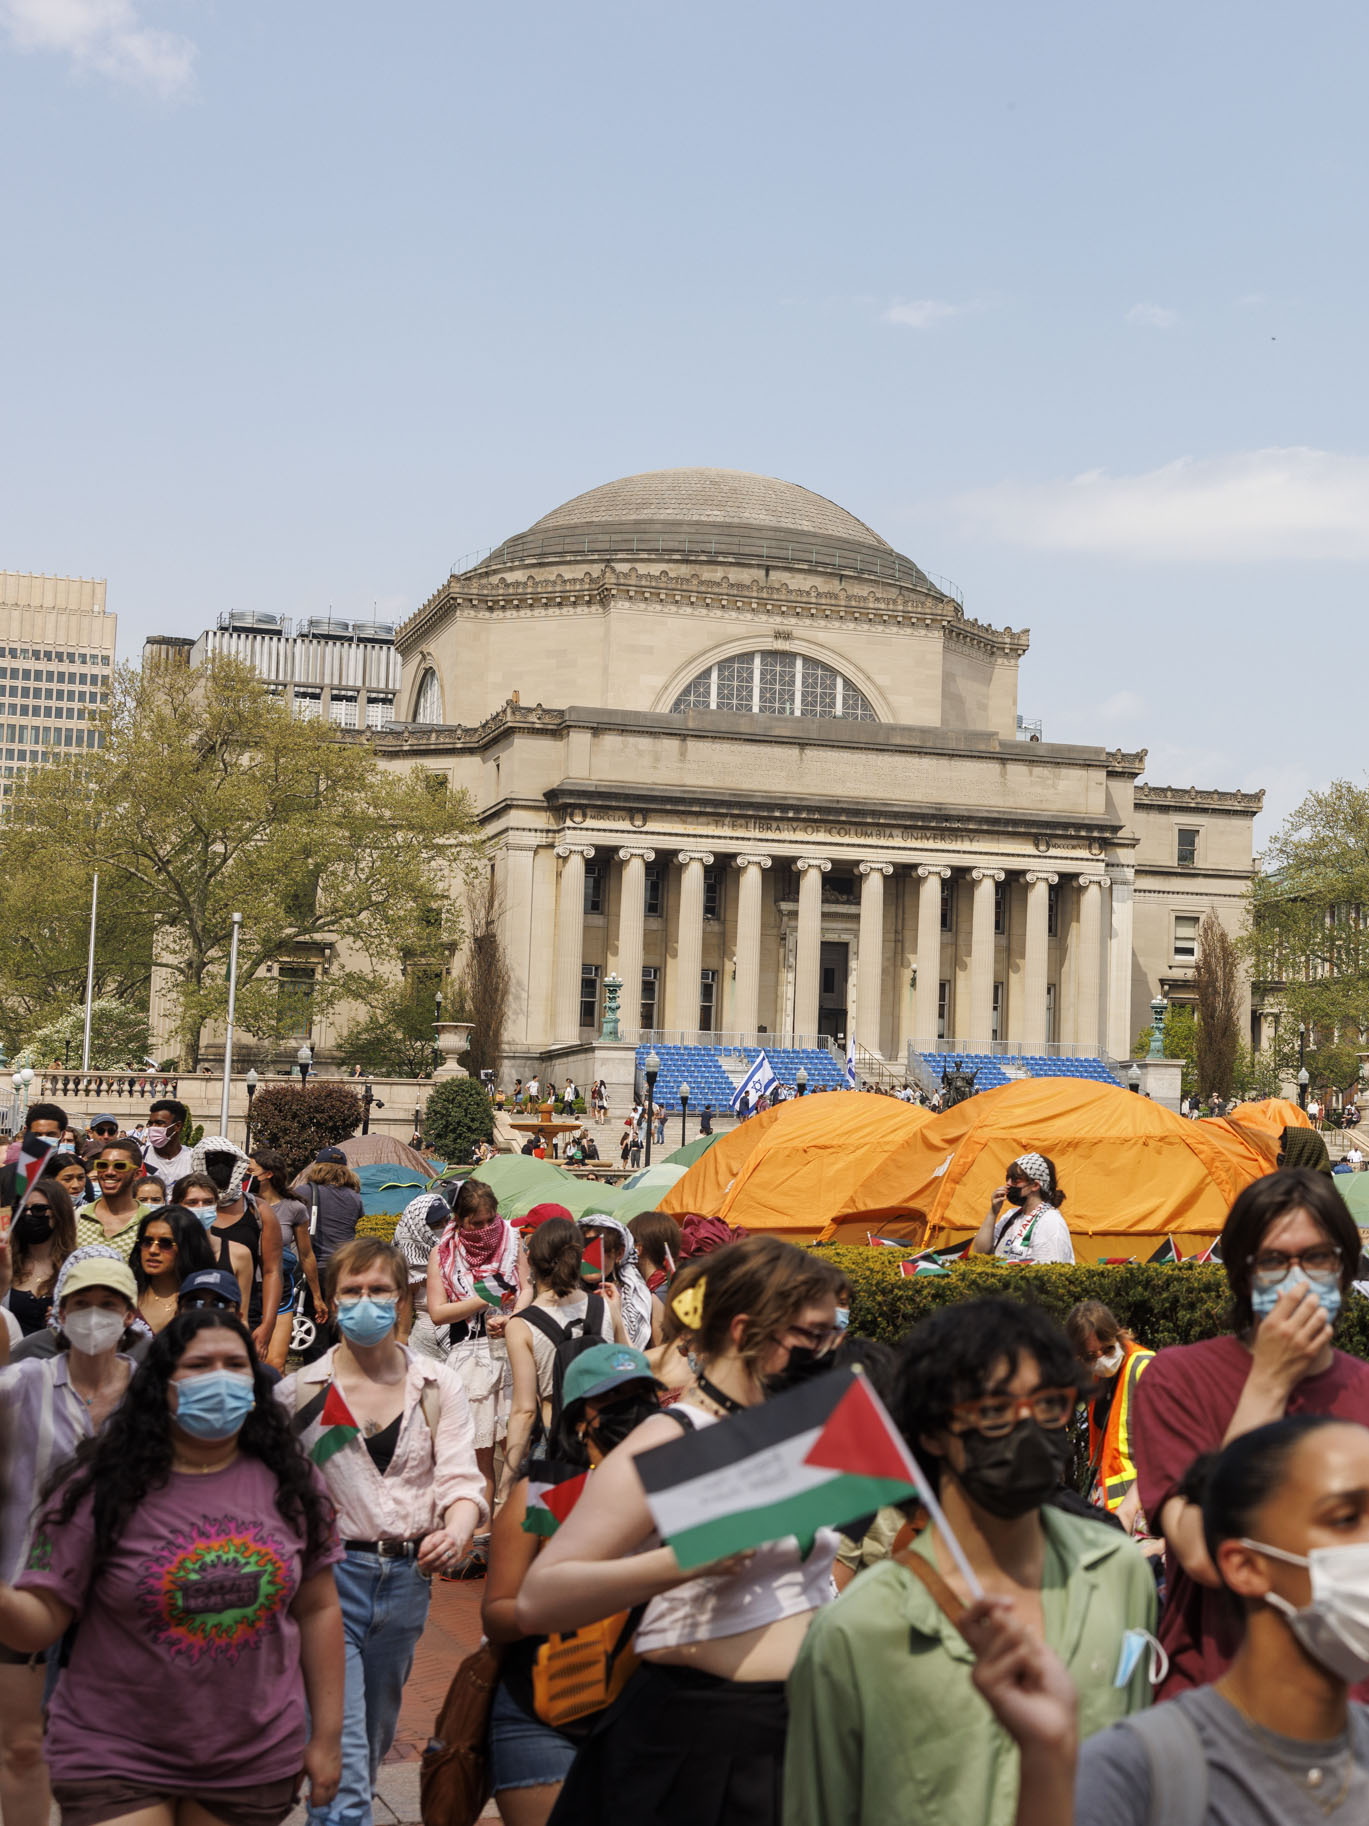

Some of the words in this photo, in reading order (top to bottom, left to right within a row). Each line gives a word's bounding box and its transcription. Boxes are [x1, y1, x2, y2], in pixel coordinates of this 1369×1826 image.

[714, 817, 738, 831] THE
[745, 819, 799, 835] LIBRARY
[805, 823, 823, 837] OF
[829, 826, 896, 841] COLUMBIA
[901, 831, 977, 846] UNIVERSITY
